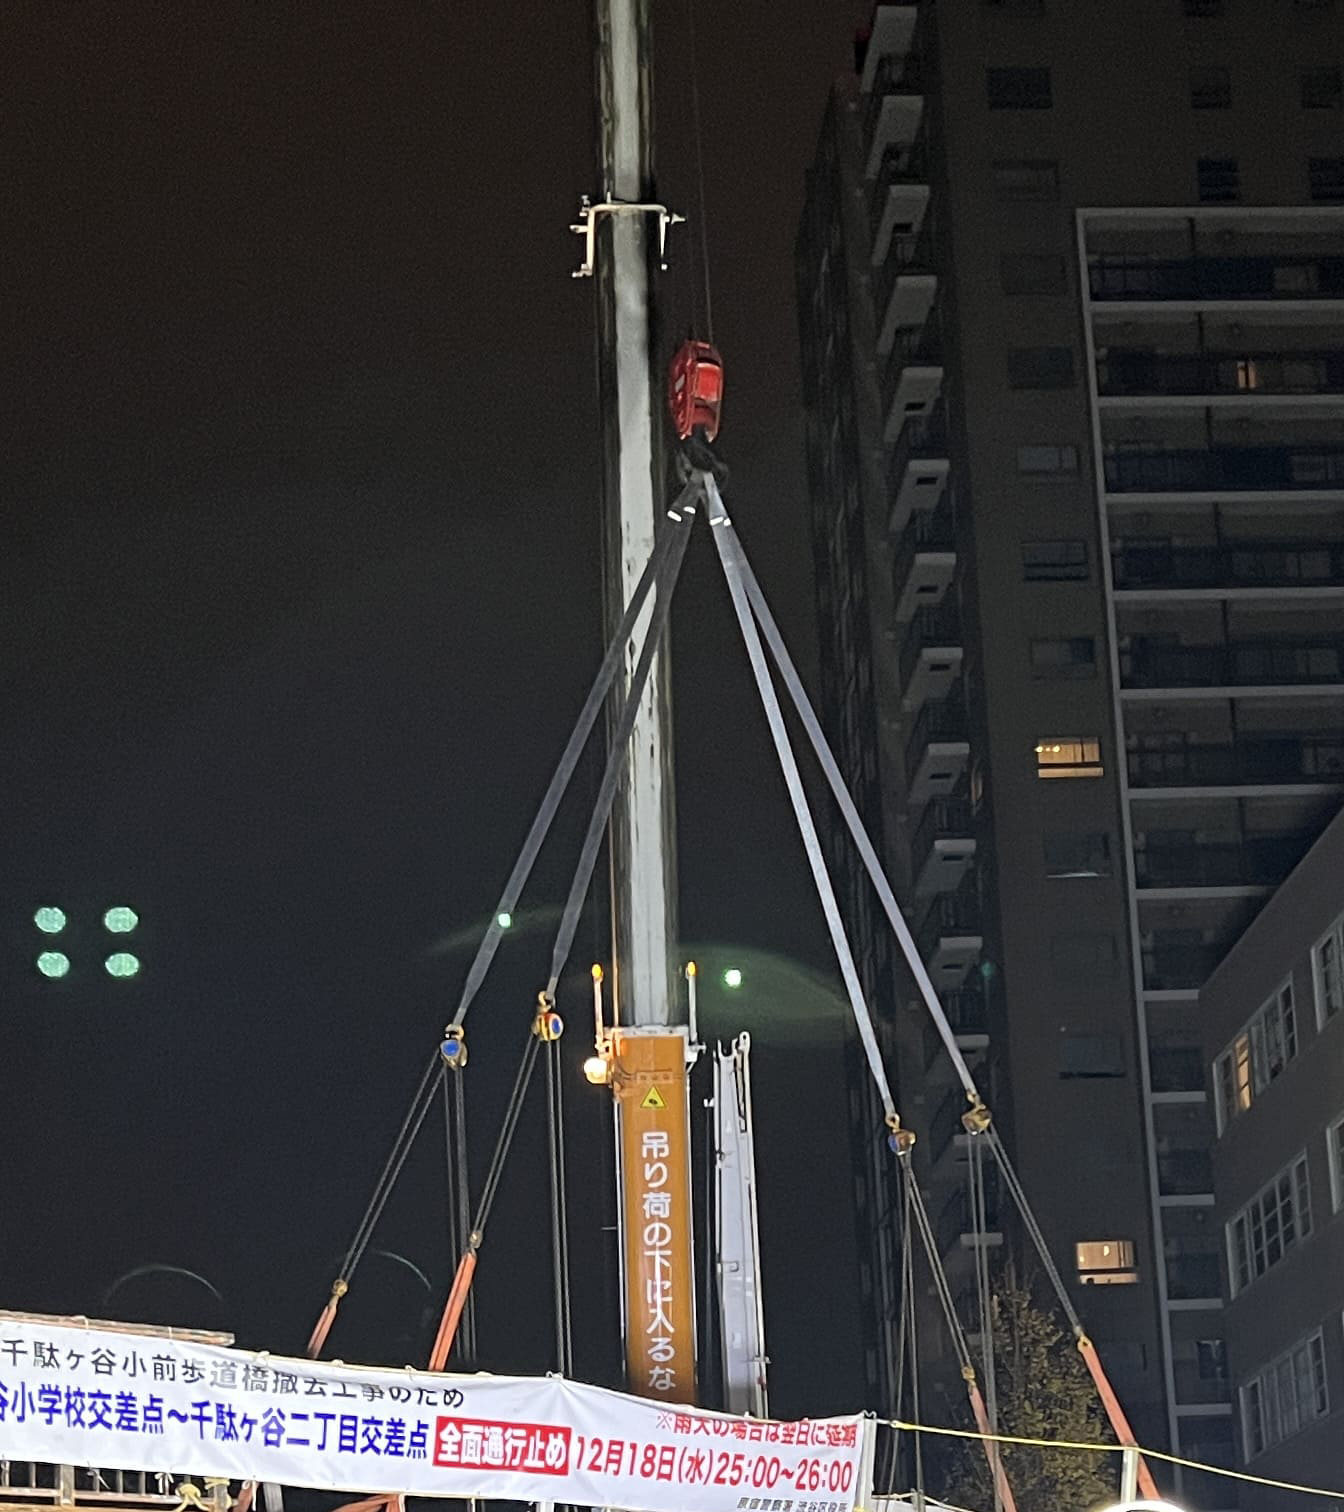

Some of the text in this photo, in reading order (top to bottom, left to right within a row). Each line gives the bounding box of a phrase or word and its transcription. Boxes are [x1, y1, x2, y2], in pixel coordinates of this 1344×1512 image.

[642, 1131, 676, 1391] 吊り荷の下に入るな
[437, 1421, 568, 1470] 全面通行止め
